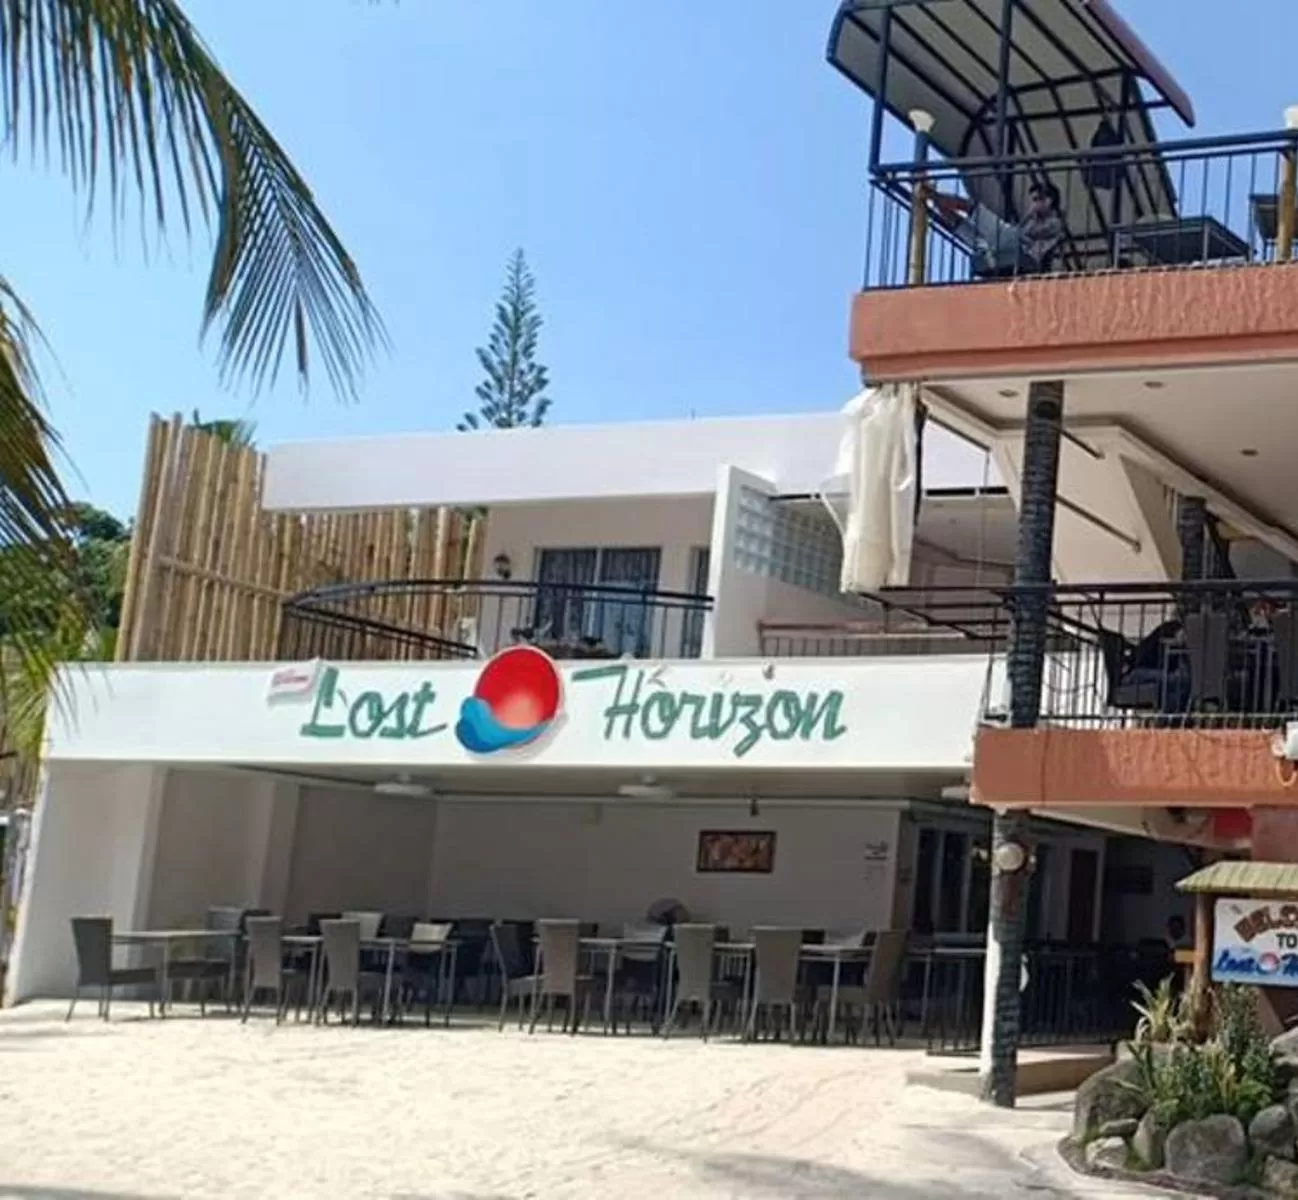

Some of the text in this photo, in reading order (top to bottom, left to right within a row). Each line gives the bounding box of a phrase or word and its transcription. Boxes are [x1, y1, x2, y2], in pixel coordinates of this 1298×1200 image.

[300, 664, 848, 758] Lost Horizon
[1276, 933, 1298, 950] TO
[1215, 949, 1255, 972] Lost
